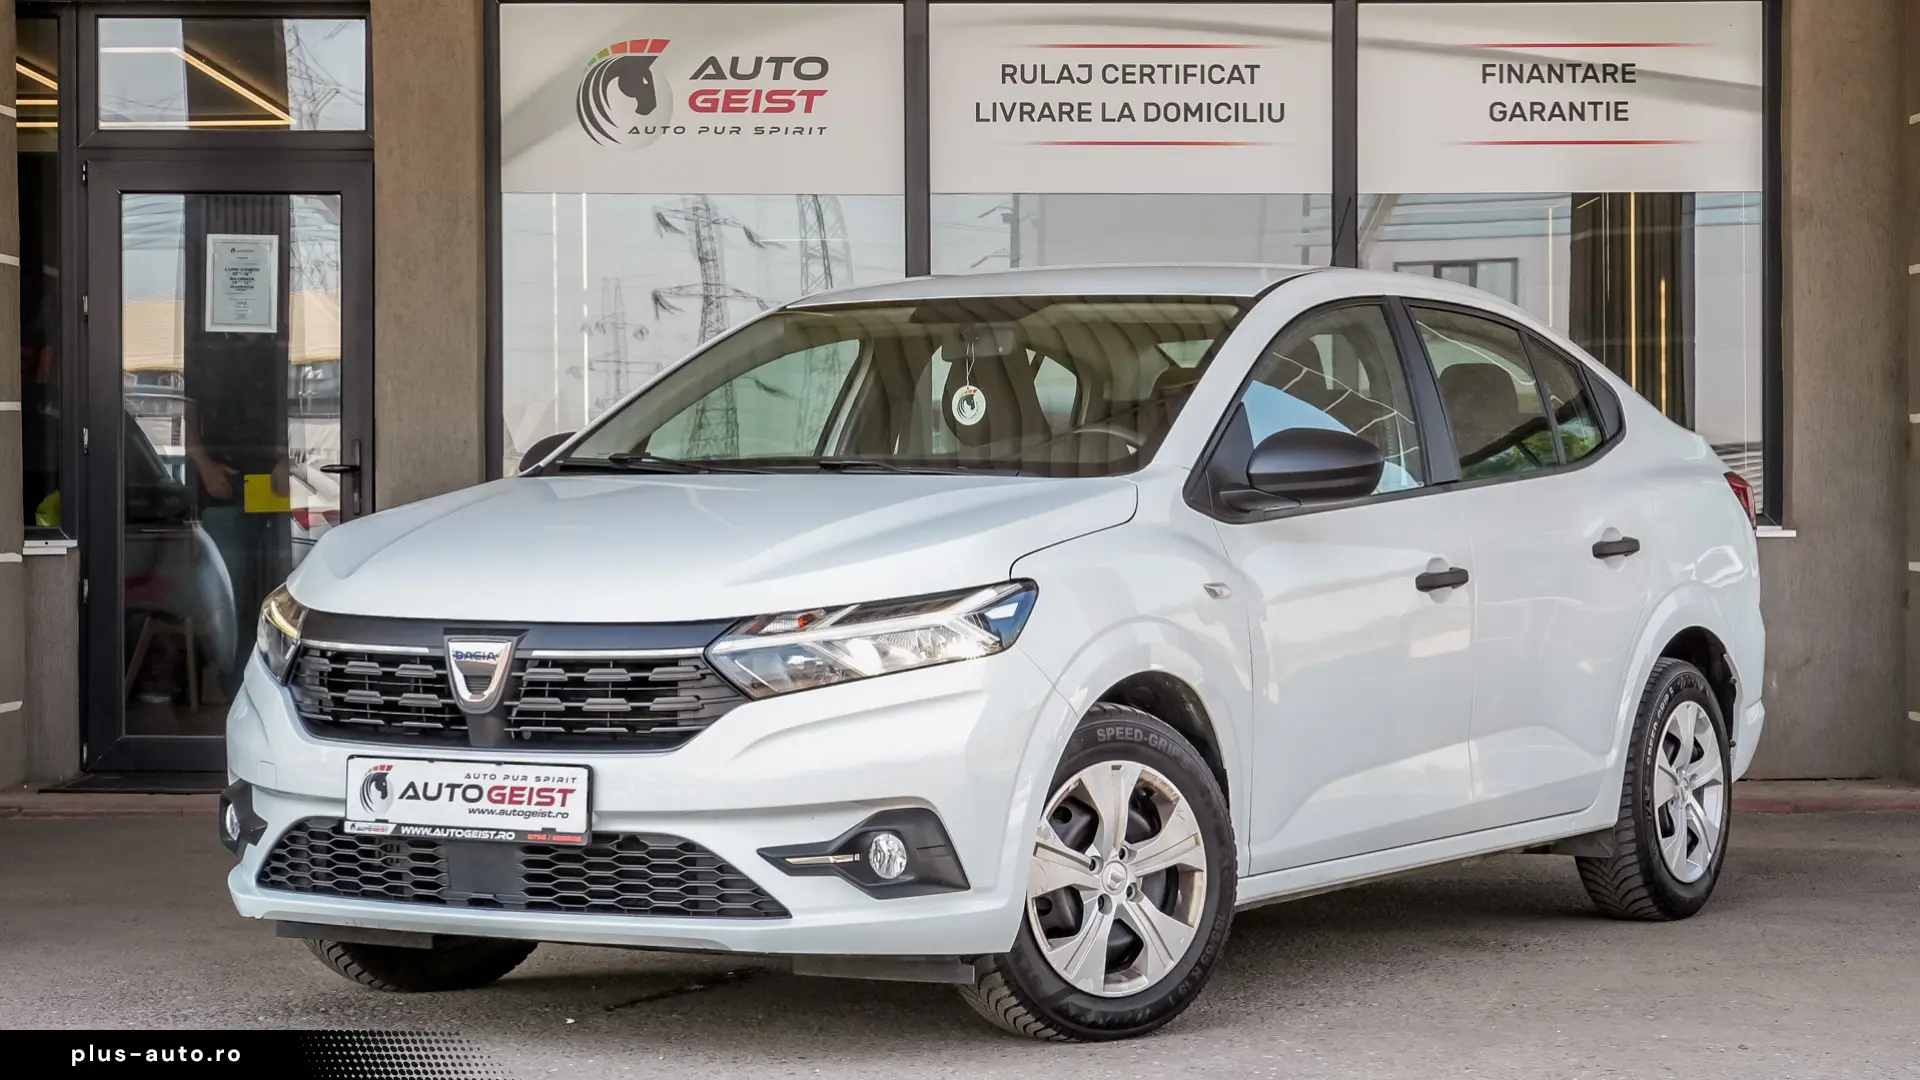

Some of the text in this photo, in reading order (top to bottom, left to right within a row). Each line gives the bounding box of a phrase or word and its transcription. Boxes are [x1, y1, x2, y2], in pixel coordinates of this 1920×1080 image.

[688, 55, 830, 81] AUTO
[1001, 63, 1261, 85] RULAJ CERTIFICAT
[1481, 62, 1637, 84] FINANTARE
[688, 88, 829, 113] GEIST
[1489, 100, 1629, 122] GARANTIE
[975, 102, 1286, 123] LIVRARE LA DOMICILIU
[627, 125, 828, 136] AUTO PUR SPIRIT
[455, 650, 497, 661] DACIA
[463, 772, 578, 784] AUTO PUR SPIRIT
[467, 806, 570, 819] www.autogeist.ro
[401, 825, 516, 841] WWW.AUTOGEIST.RO
